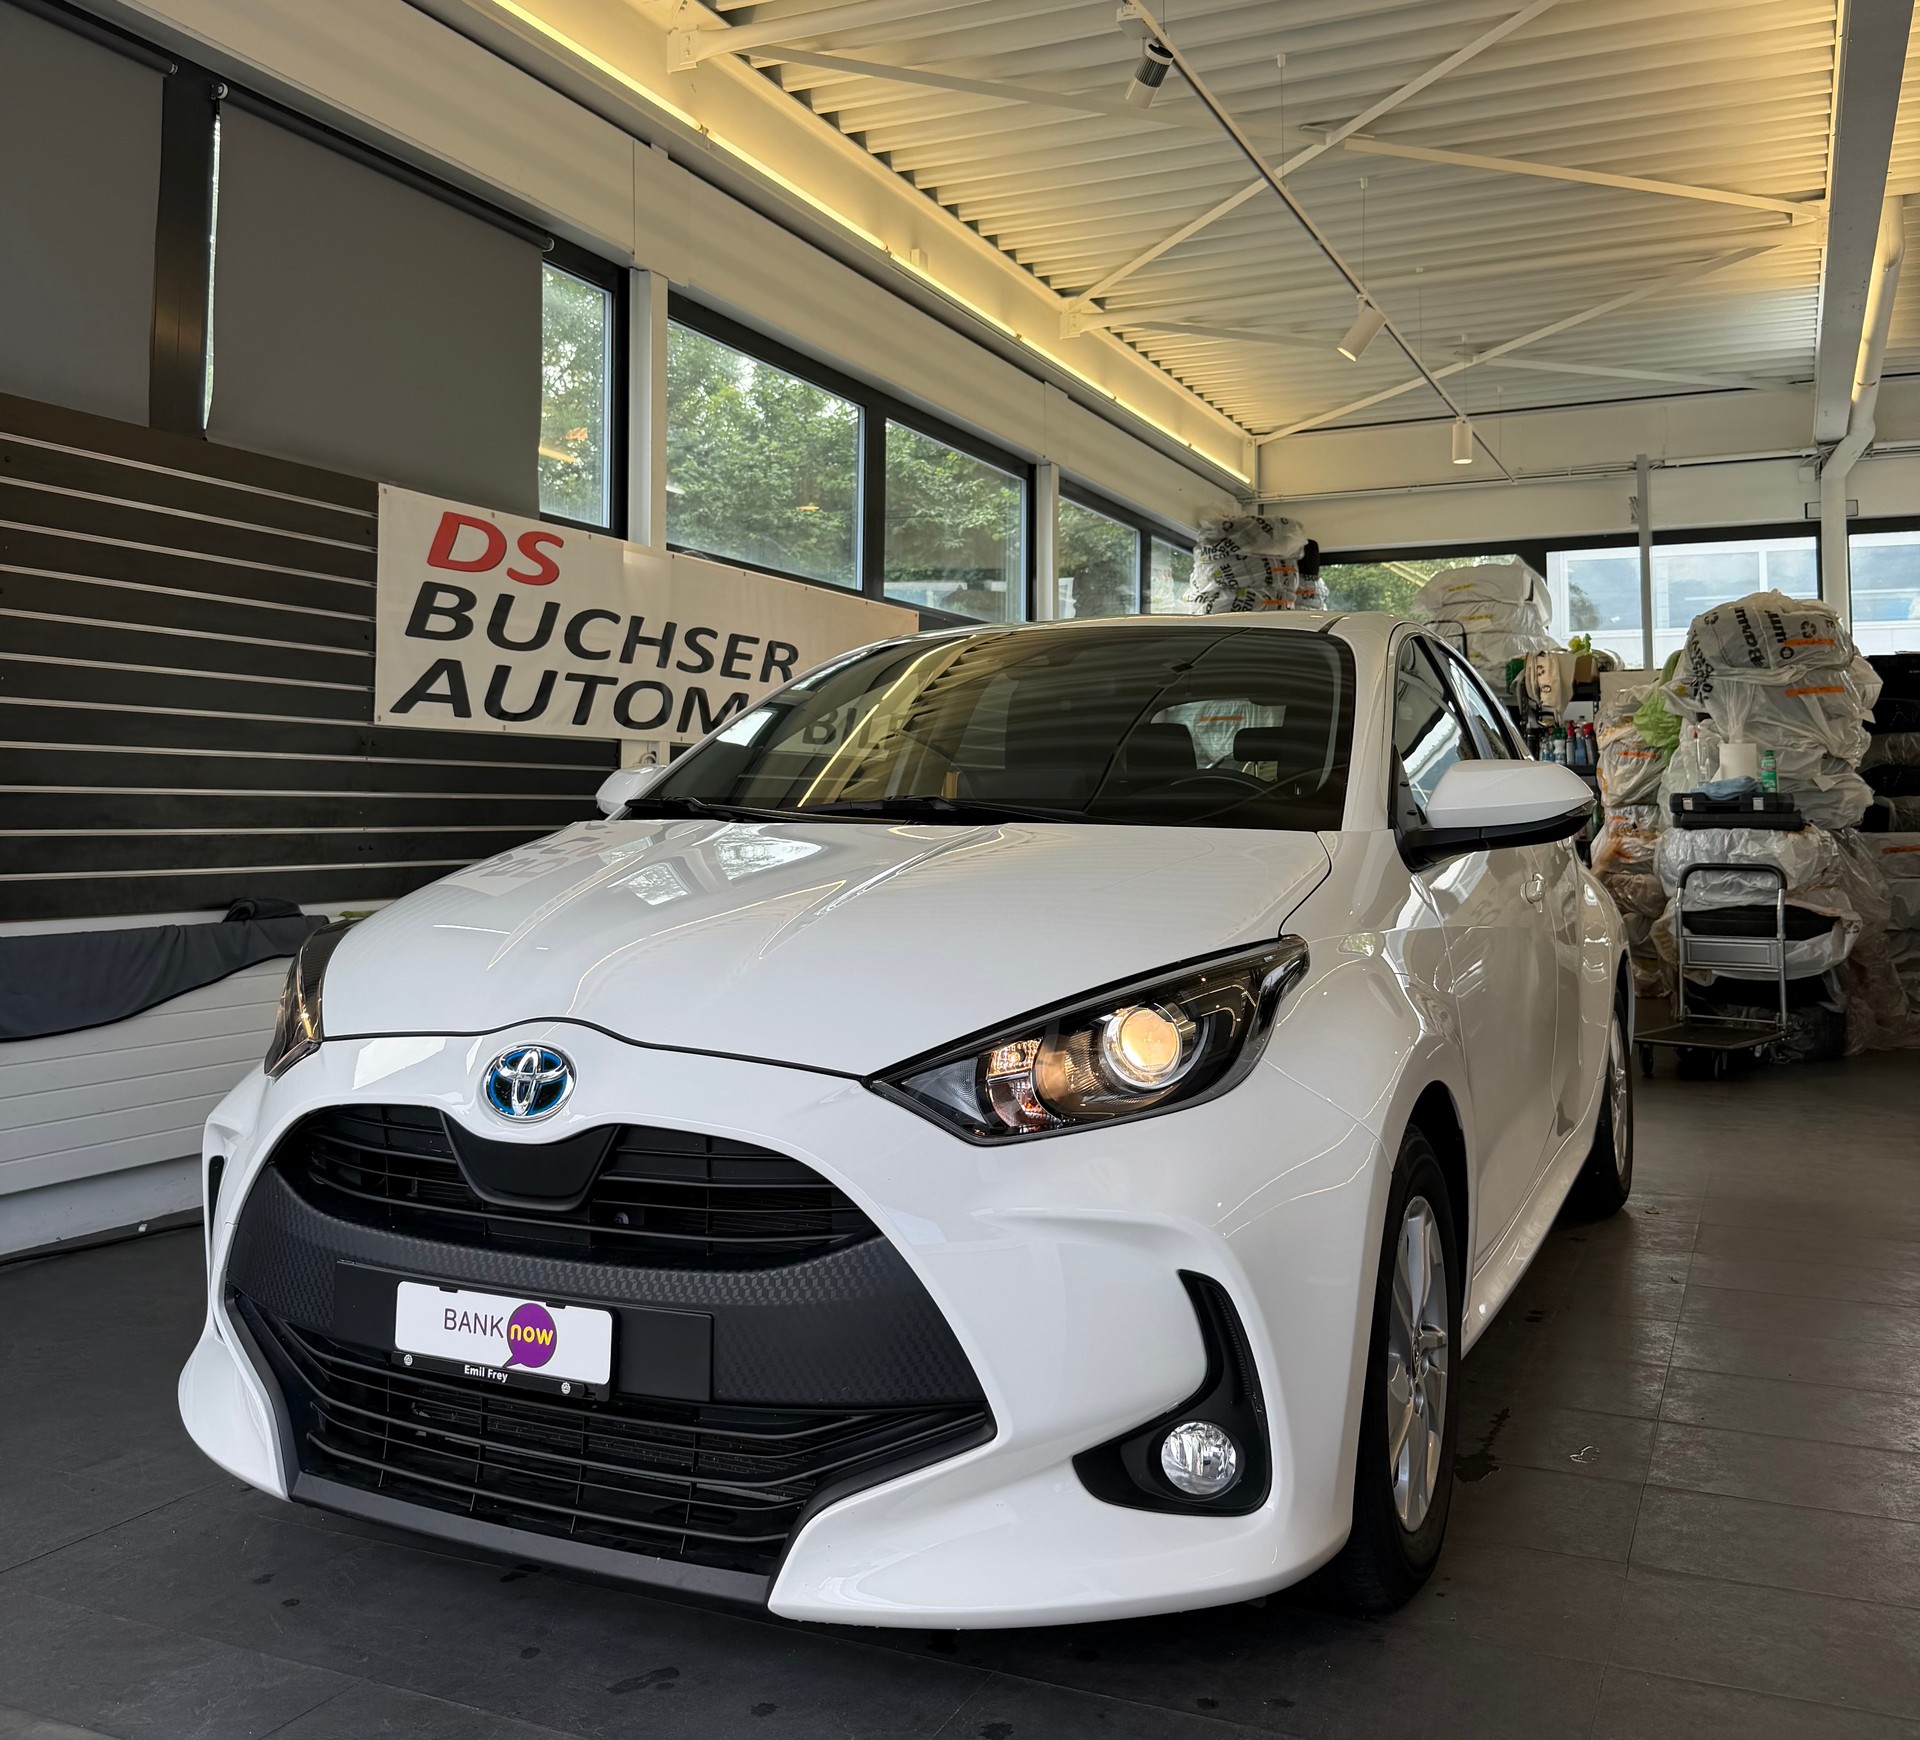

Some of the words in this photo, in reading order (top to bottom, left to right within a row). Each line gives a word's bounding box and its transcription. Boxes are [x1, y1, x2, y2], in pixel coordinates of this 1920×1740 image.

[427, 512, 563, 585] DS
[405, 581, 799, 684] BUCHSER
[443, 1307, 504, 1339] BANK
[510, 1324, 553, 1345] now
[464, 1365, 485, 1377] Emil
[487, 1368, 508, 1384] Frey
